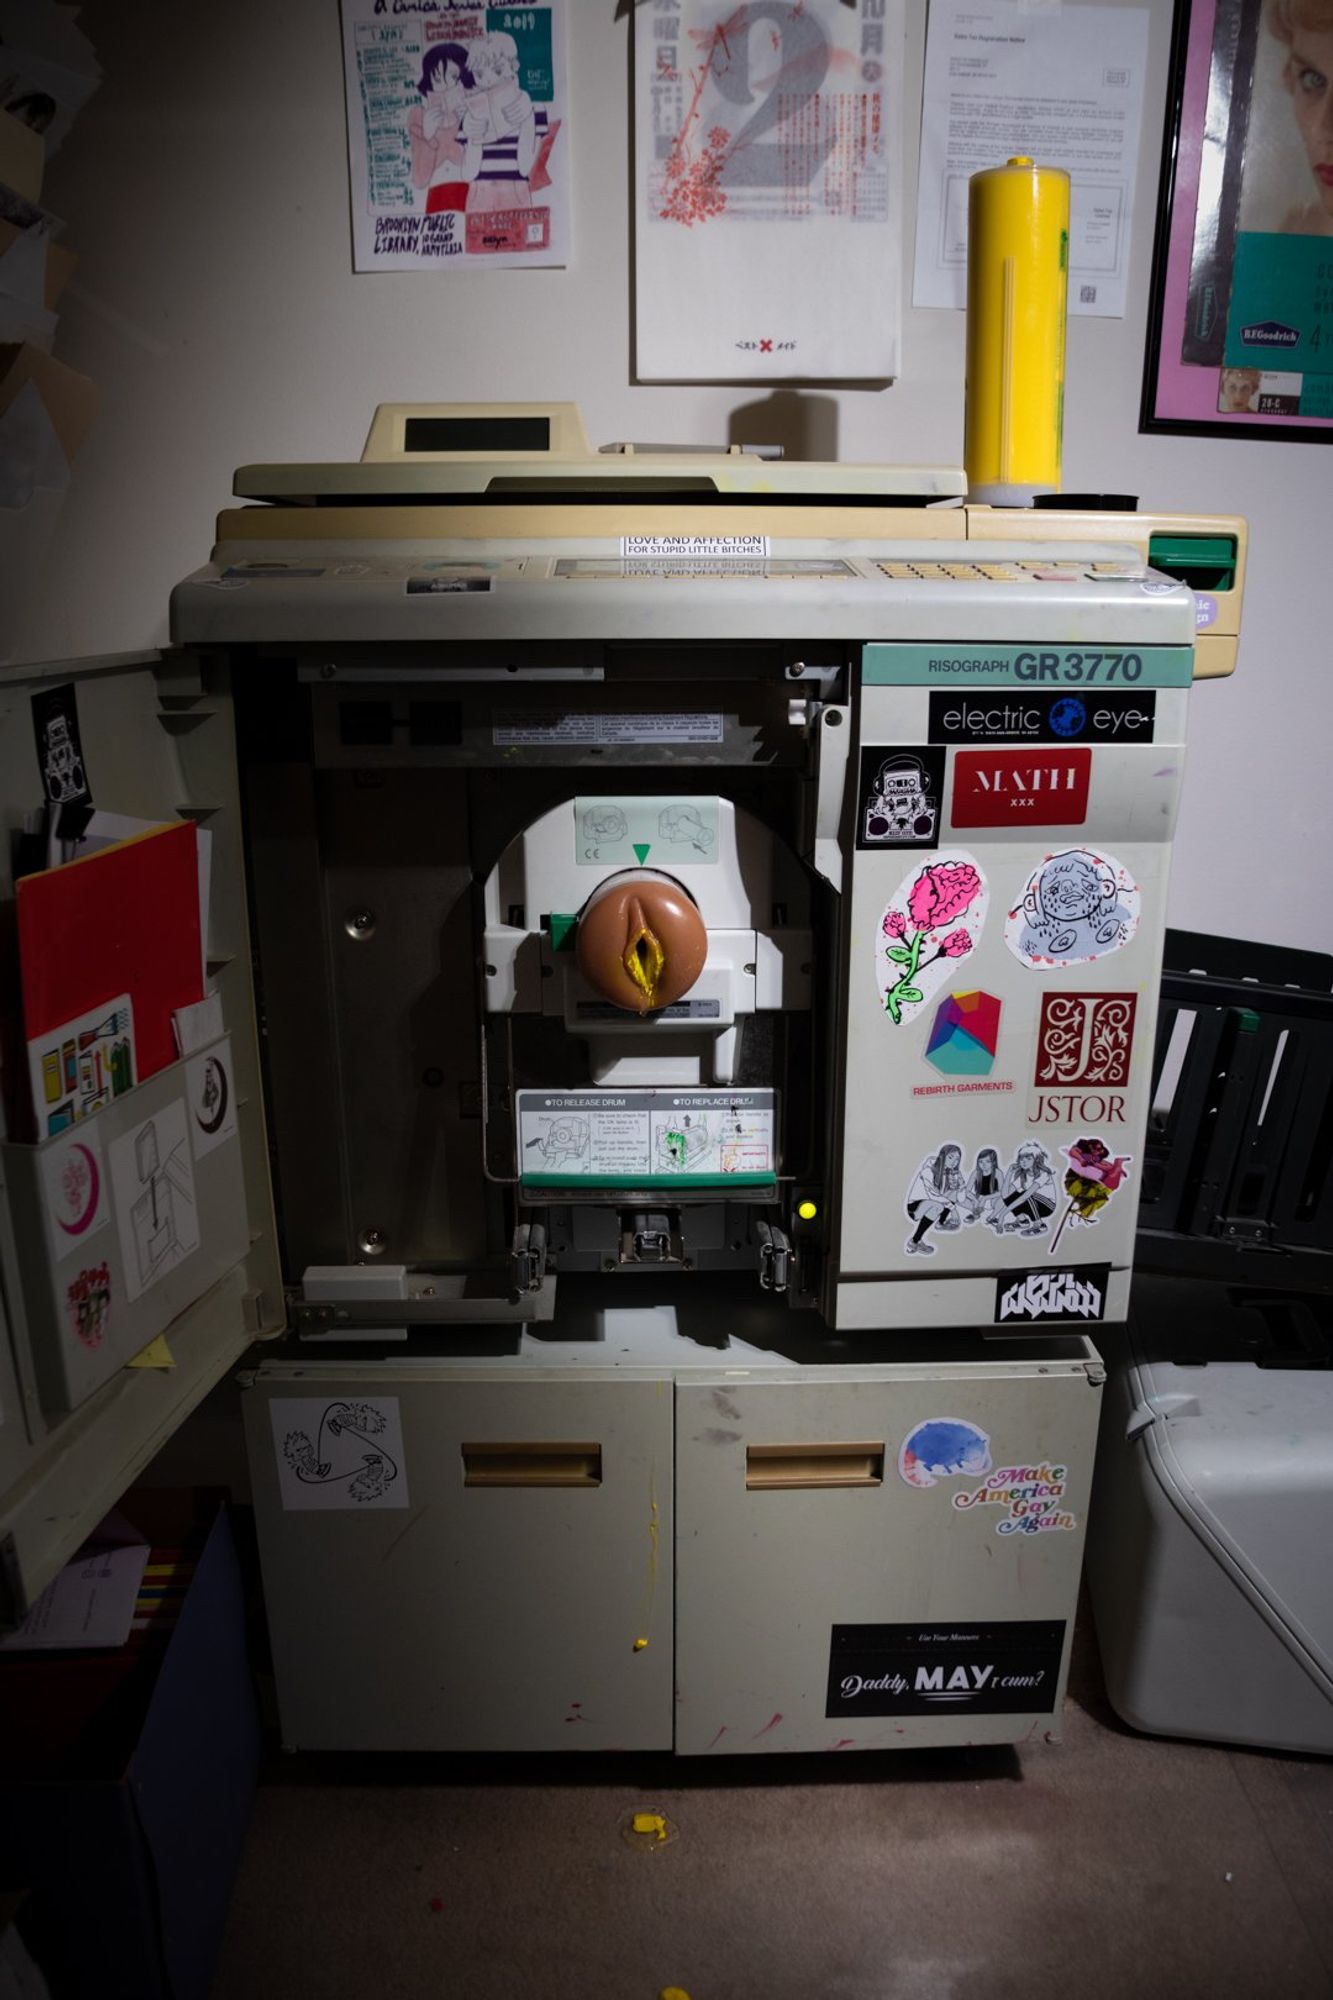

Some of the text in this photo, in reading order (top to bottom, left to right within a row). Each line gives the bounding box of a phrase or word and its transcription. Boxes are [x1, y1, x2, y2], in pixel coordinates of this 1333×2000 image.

[504, 12, 535, 31] 2019
[375, 216, 420, 235] BROOKLYN
[420, 213, 455, 235] PUBLIC
[430, 232, 454, 243] GRAND
[421, 242, 463, 256] ARMY PLAZA
[628, 536, 761, 545] LOVE AND AFFECTION
[650, 546, 686, 554] STUPID
[928, 660, 1009, 673] RISOGRAPH
[943, 701, 1143, 734] electric eye
[973, 767, 1077, 793] MATH
[912, 1081, 1013, 1096] REBIRTH GARMENTS
[552, 1099, 563, 1107] TO
[564, 1099, 601, 1107] RELEASE
[680, 1098, 691, 1106] TO
[692, 1098, 729, 1106] REPLACE
[1028, 1095, 1126, 1123] JSTOR
[987, 1466, 1064, 1489] Make
[955, 1483, 1062, 1508] America
[1012, 1499, 1056, 1518] Gay
[998, 1512, 1074, 1533] Again
[918, 1633, 932, 1641] Use
[933, 1633, 949, 1641] Your
[840, 1673, 910, 1699] Daddy,
[914, 1664, 995, 1690] MAY
[1000, 1670, 1045, 1687] cum?
